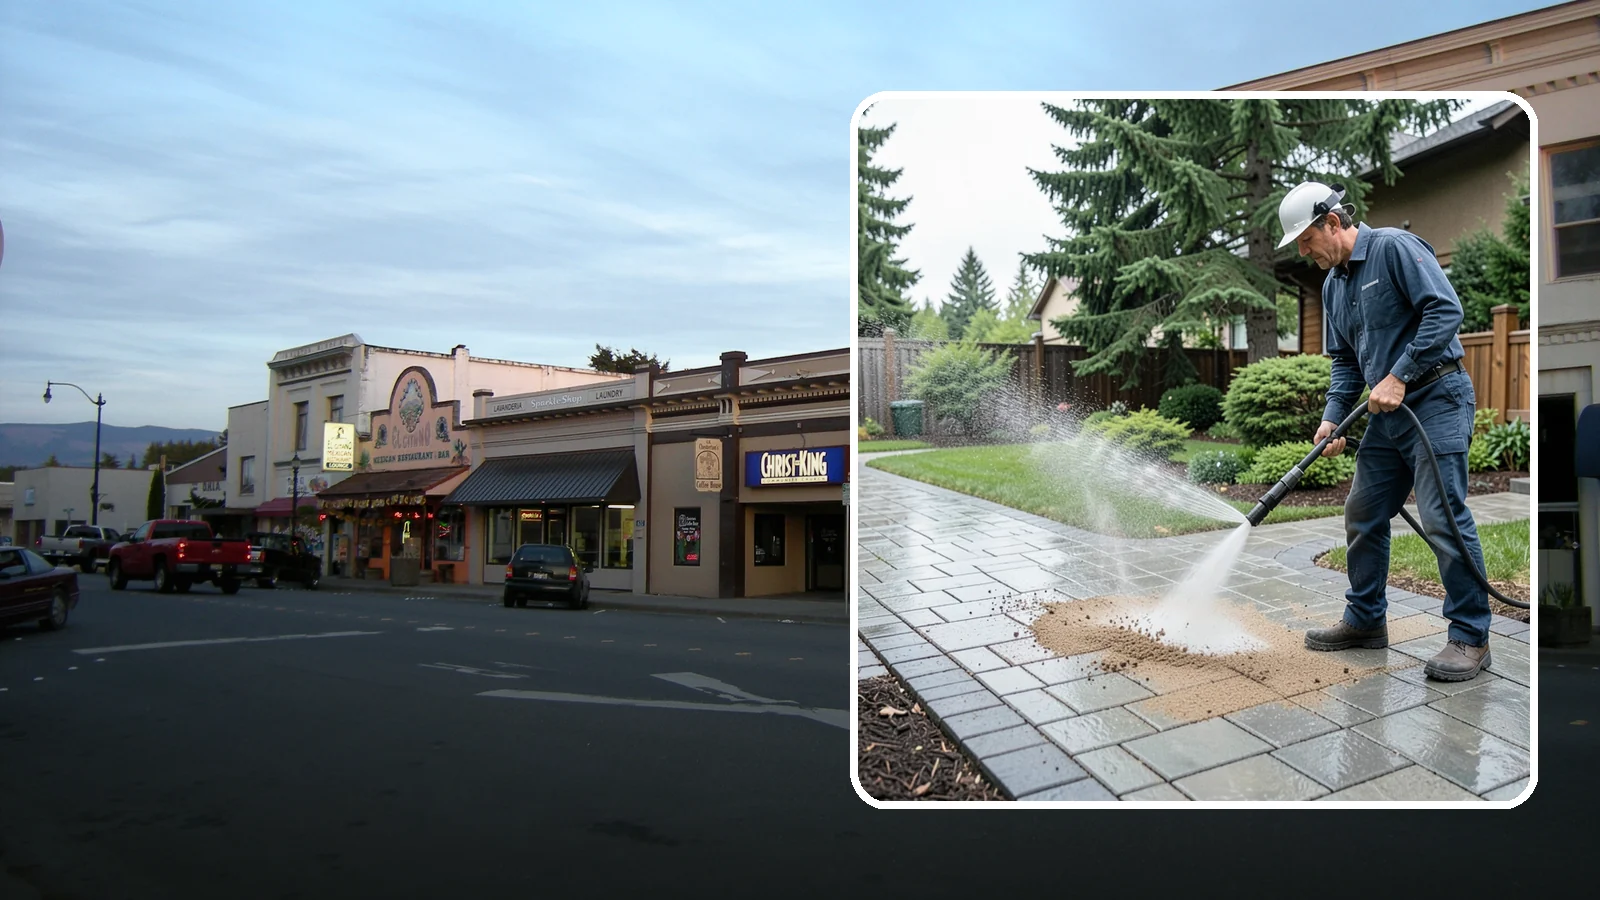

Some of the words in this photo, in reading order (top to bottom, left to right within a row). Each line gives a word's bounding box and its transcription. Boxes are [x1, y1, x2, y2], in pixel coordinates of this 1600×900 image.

[493, 402, 522, 412] LAVANDERIA
[531, 398, 560, 409] Sparkle
[561, 395, 582, 404] Shop
[595, 389, 623, 400] LAUNDRY
[392, 426, 401, 449] EL
[374, 455, 396, 464] MEXICAN
[398, 452, 433, 462] RESTAURANT
[438, 450, 450, 459] BAR
[760, 452, 797, 478] CHRIST
[799, 450, 828, 476] KING
[696, 480, 709, 489] Coffee
[710, 480, 722, 489] House
